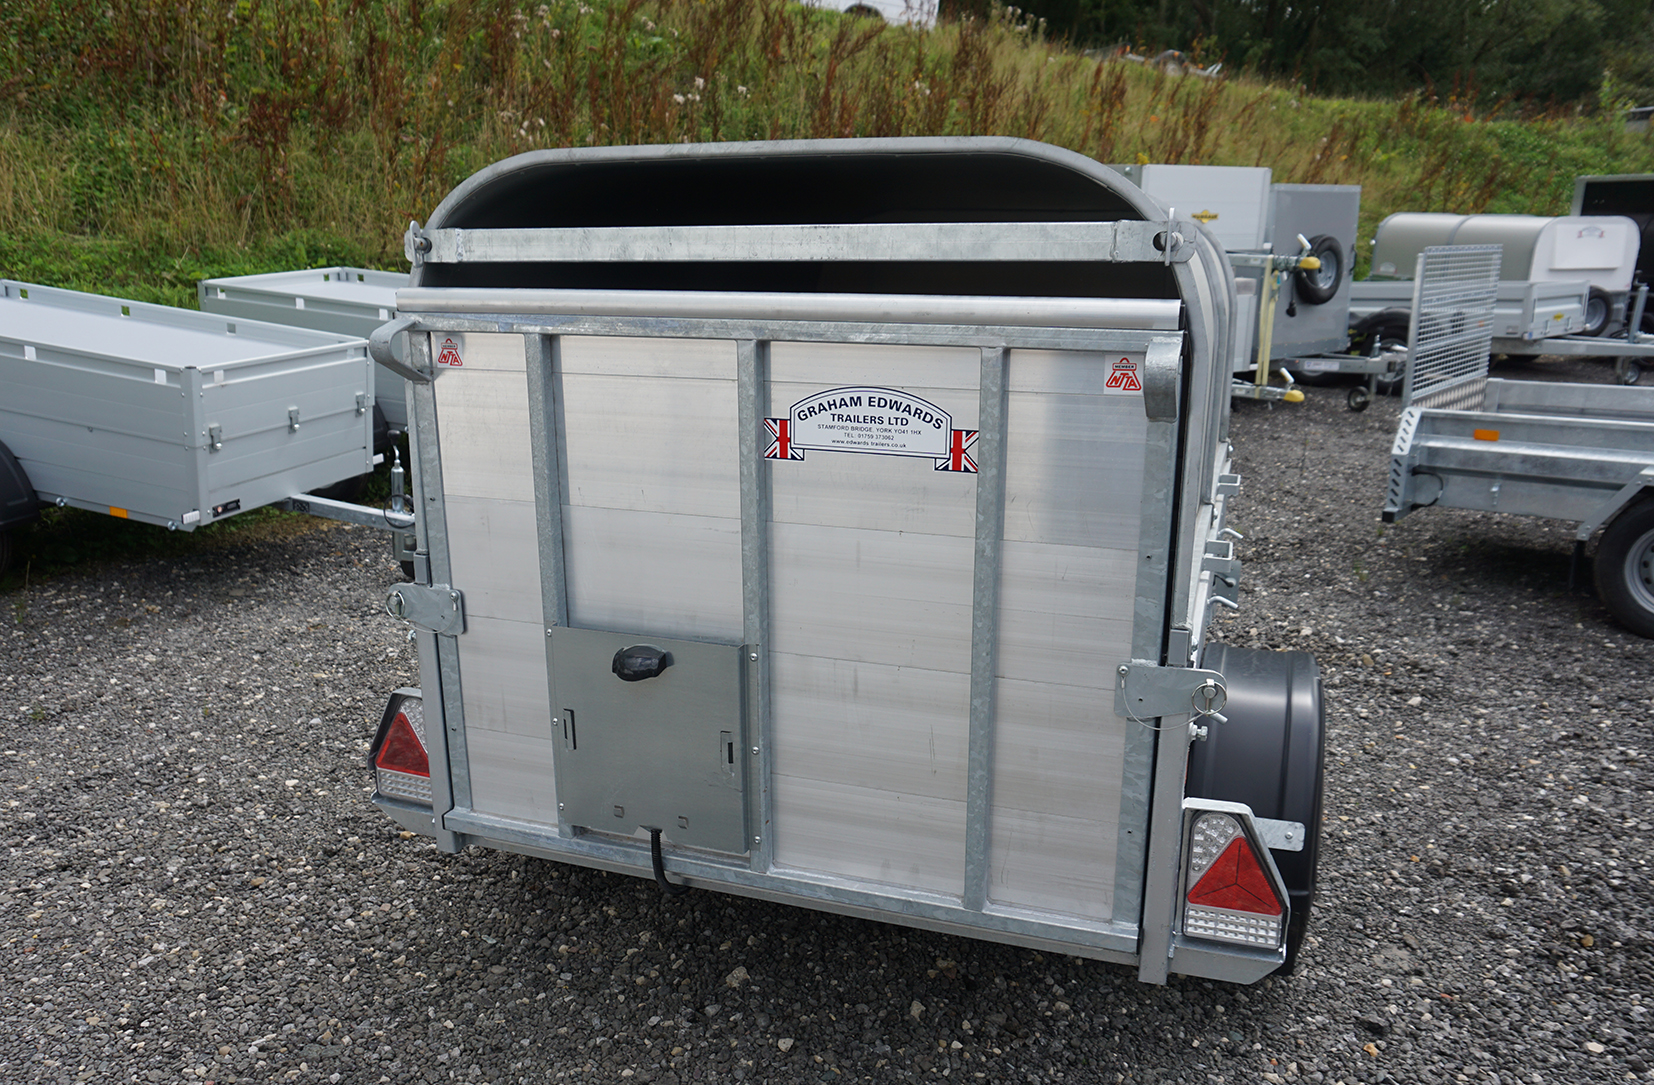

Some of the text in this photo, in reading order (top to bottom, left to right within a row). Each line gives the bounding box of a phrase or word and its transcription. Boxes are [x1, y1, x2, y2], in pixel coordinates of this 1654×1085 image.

[797, 396, 944, 430] GRAHAM EDWARDS
[830, 413, 909, 427] TRAILERS LTD
